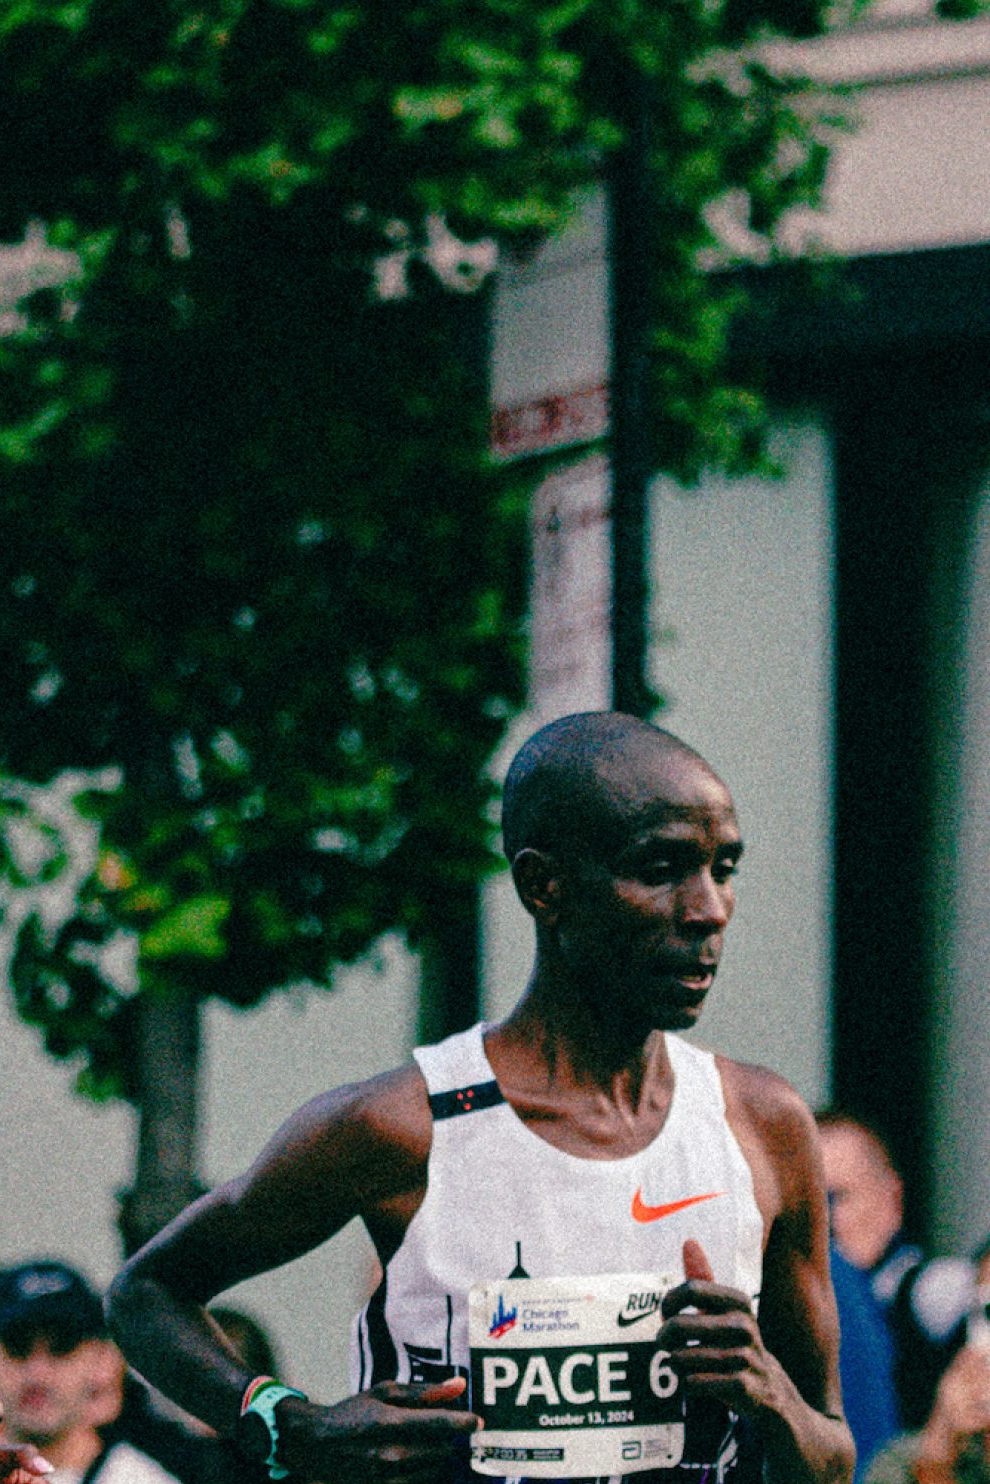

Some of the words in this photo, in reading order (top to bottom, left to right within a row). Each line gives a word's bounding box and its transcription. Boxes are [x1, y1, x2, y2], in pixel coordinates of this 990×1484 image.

[482, 1352, 632, 1406] PACE
[649, 1350, 679, 1398] 6
[538, 1413, 585, 1426] October
